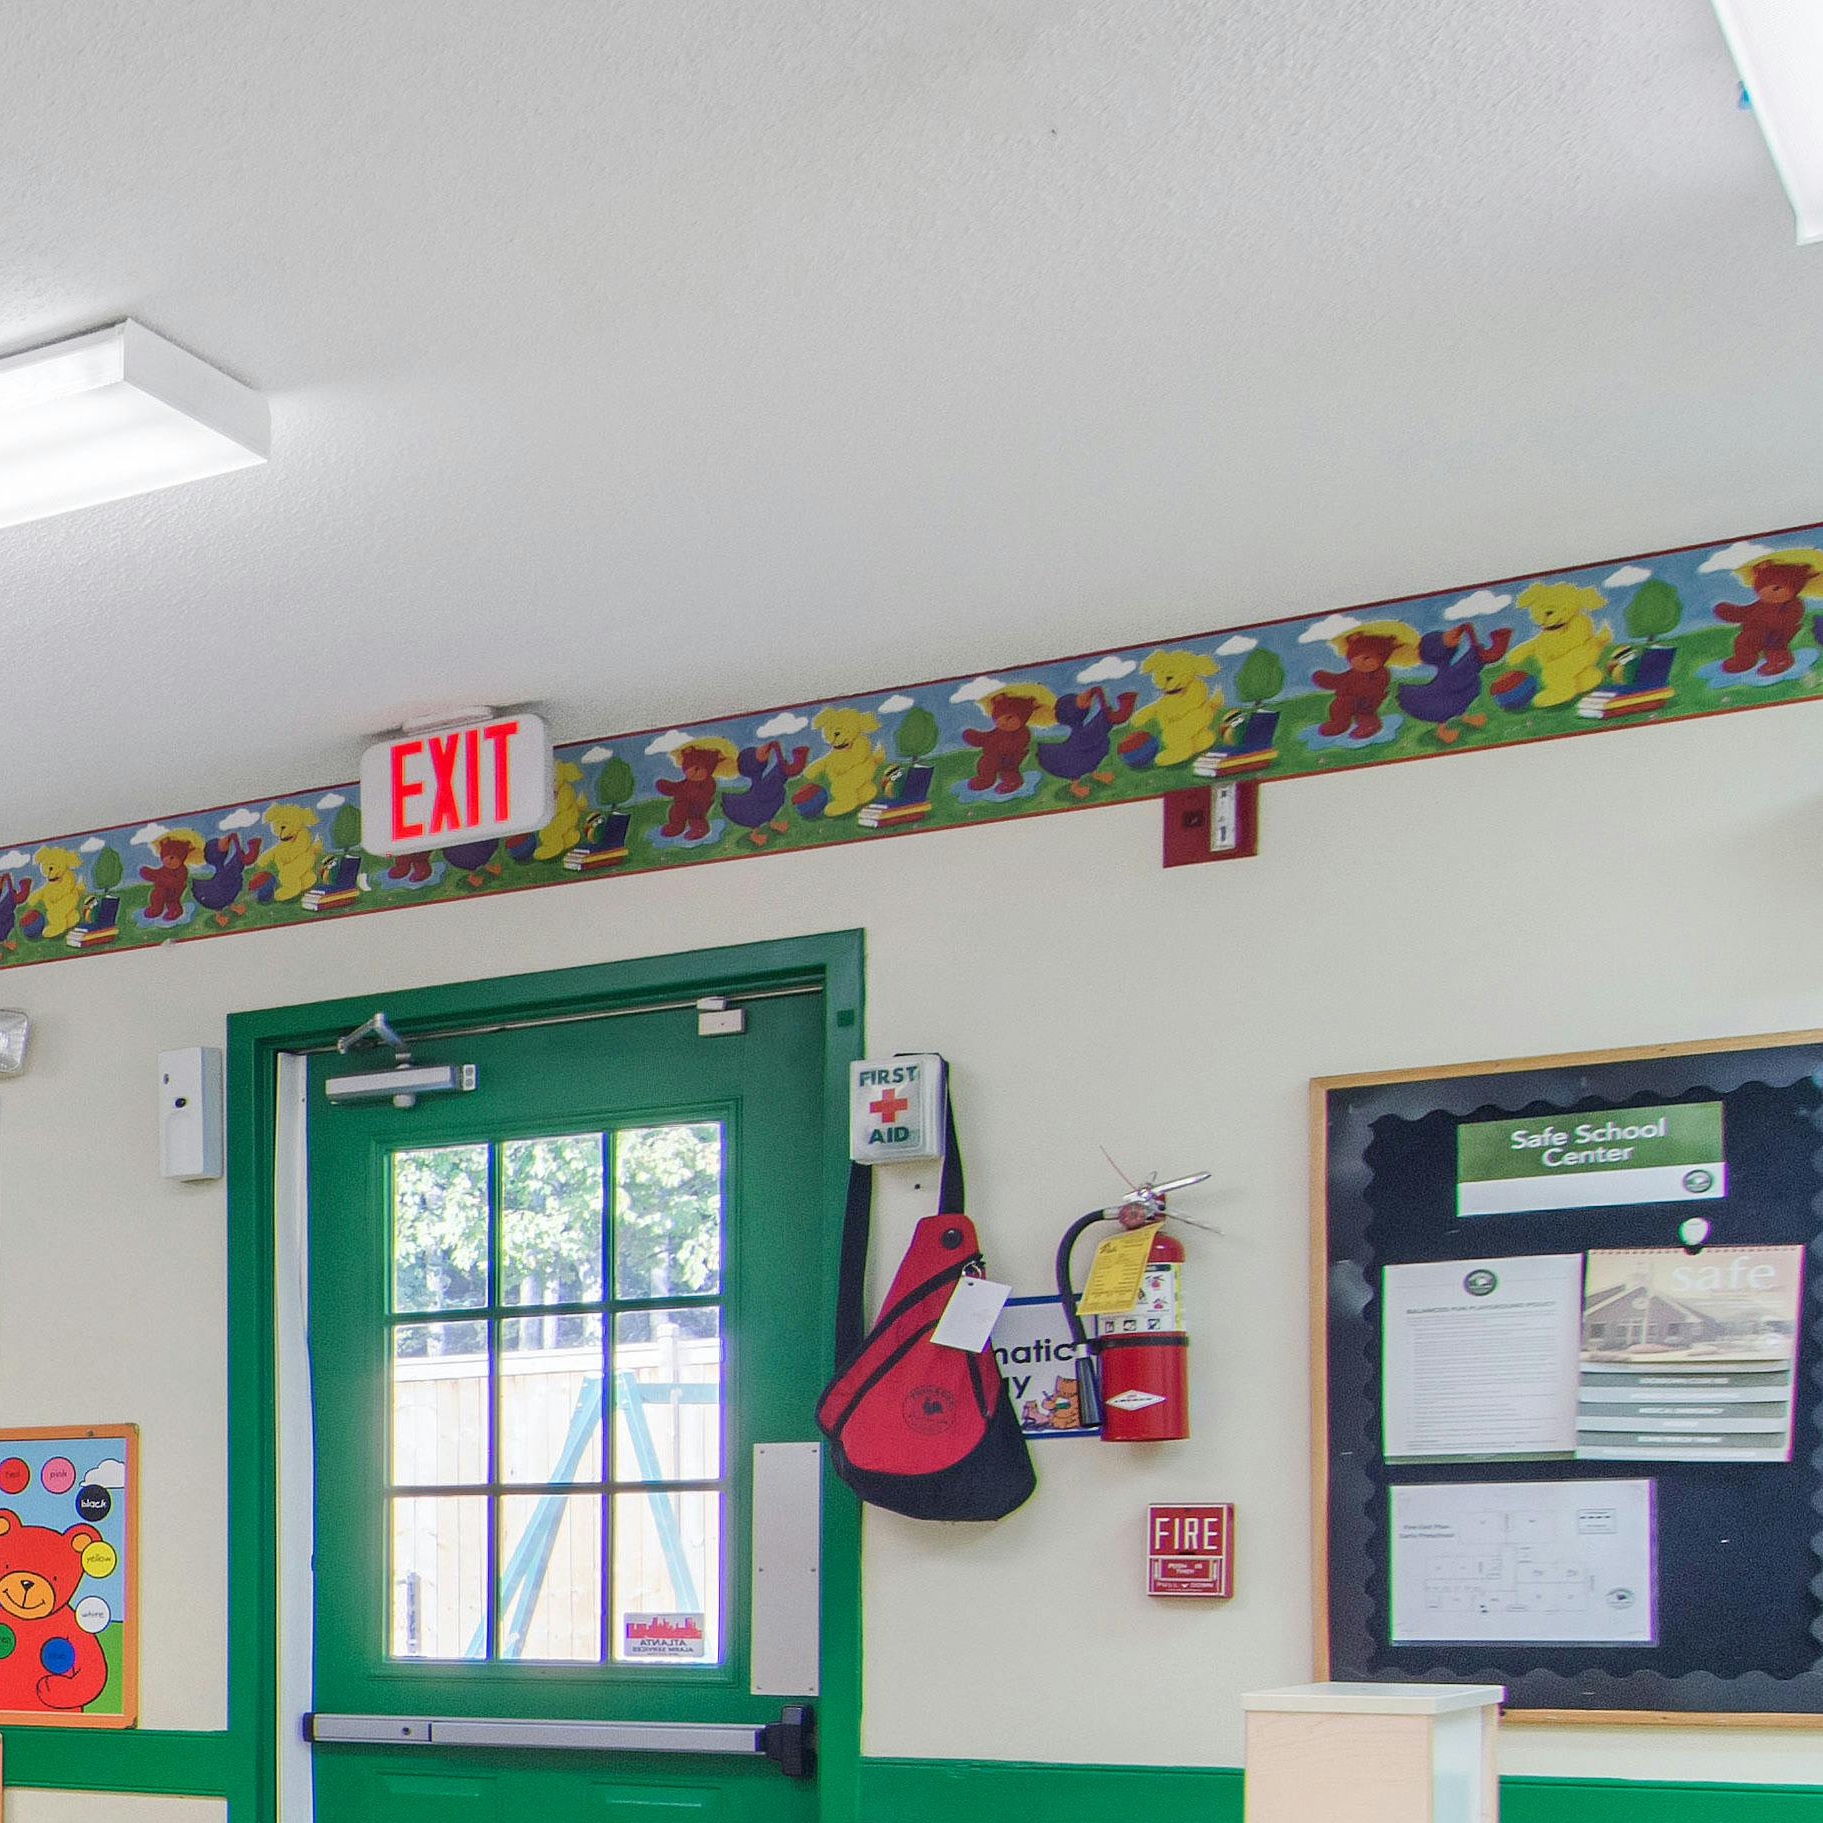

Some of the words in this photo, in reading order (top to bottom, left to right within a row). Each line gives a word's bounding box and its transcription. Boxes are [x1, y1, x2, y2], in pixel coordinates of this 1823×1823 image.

[390, 720, 519, 842] EXIT
[858, 1065, 918, 1087] FIRST
[868, 1126, 910, 1144] AID
[1510, 1126, 1569, 1150] Safe
[1573, 1116, 1668, 1145] School
[1541, 1145, 1635, 1168] Center
[1671, 1255, 1777, 1292] safe
[5, 1469, 20, 1478] red
[49, 1470, 68, 1480] pink
[80, 1498, 107, 1509] black
[1154, 1517, 1219, 1550] FIRE
[86, 1553, 112, 1564] yellow
[81, 1611, 105, 1619] white
